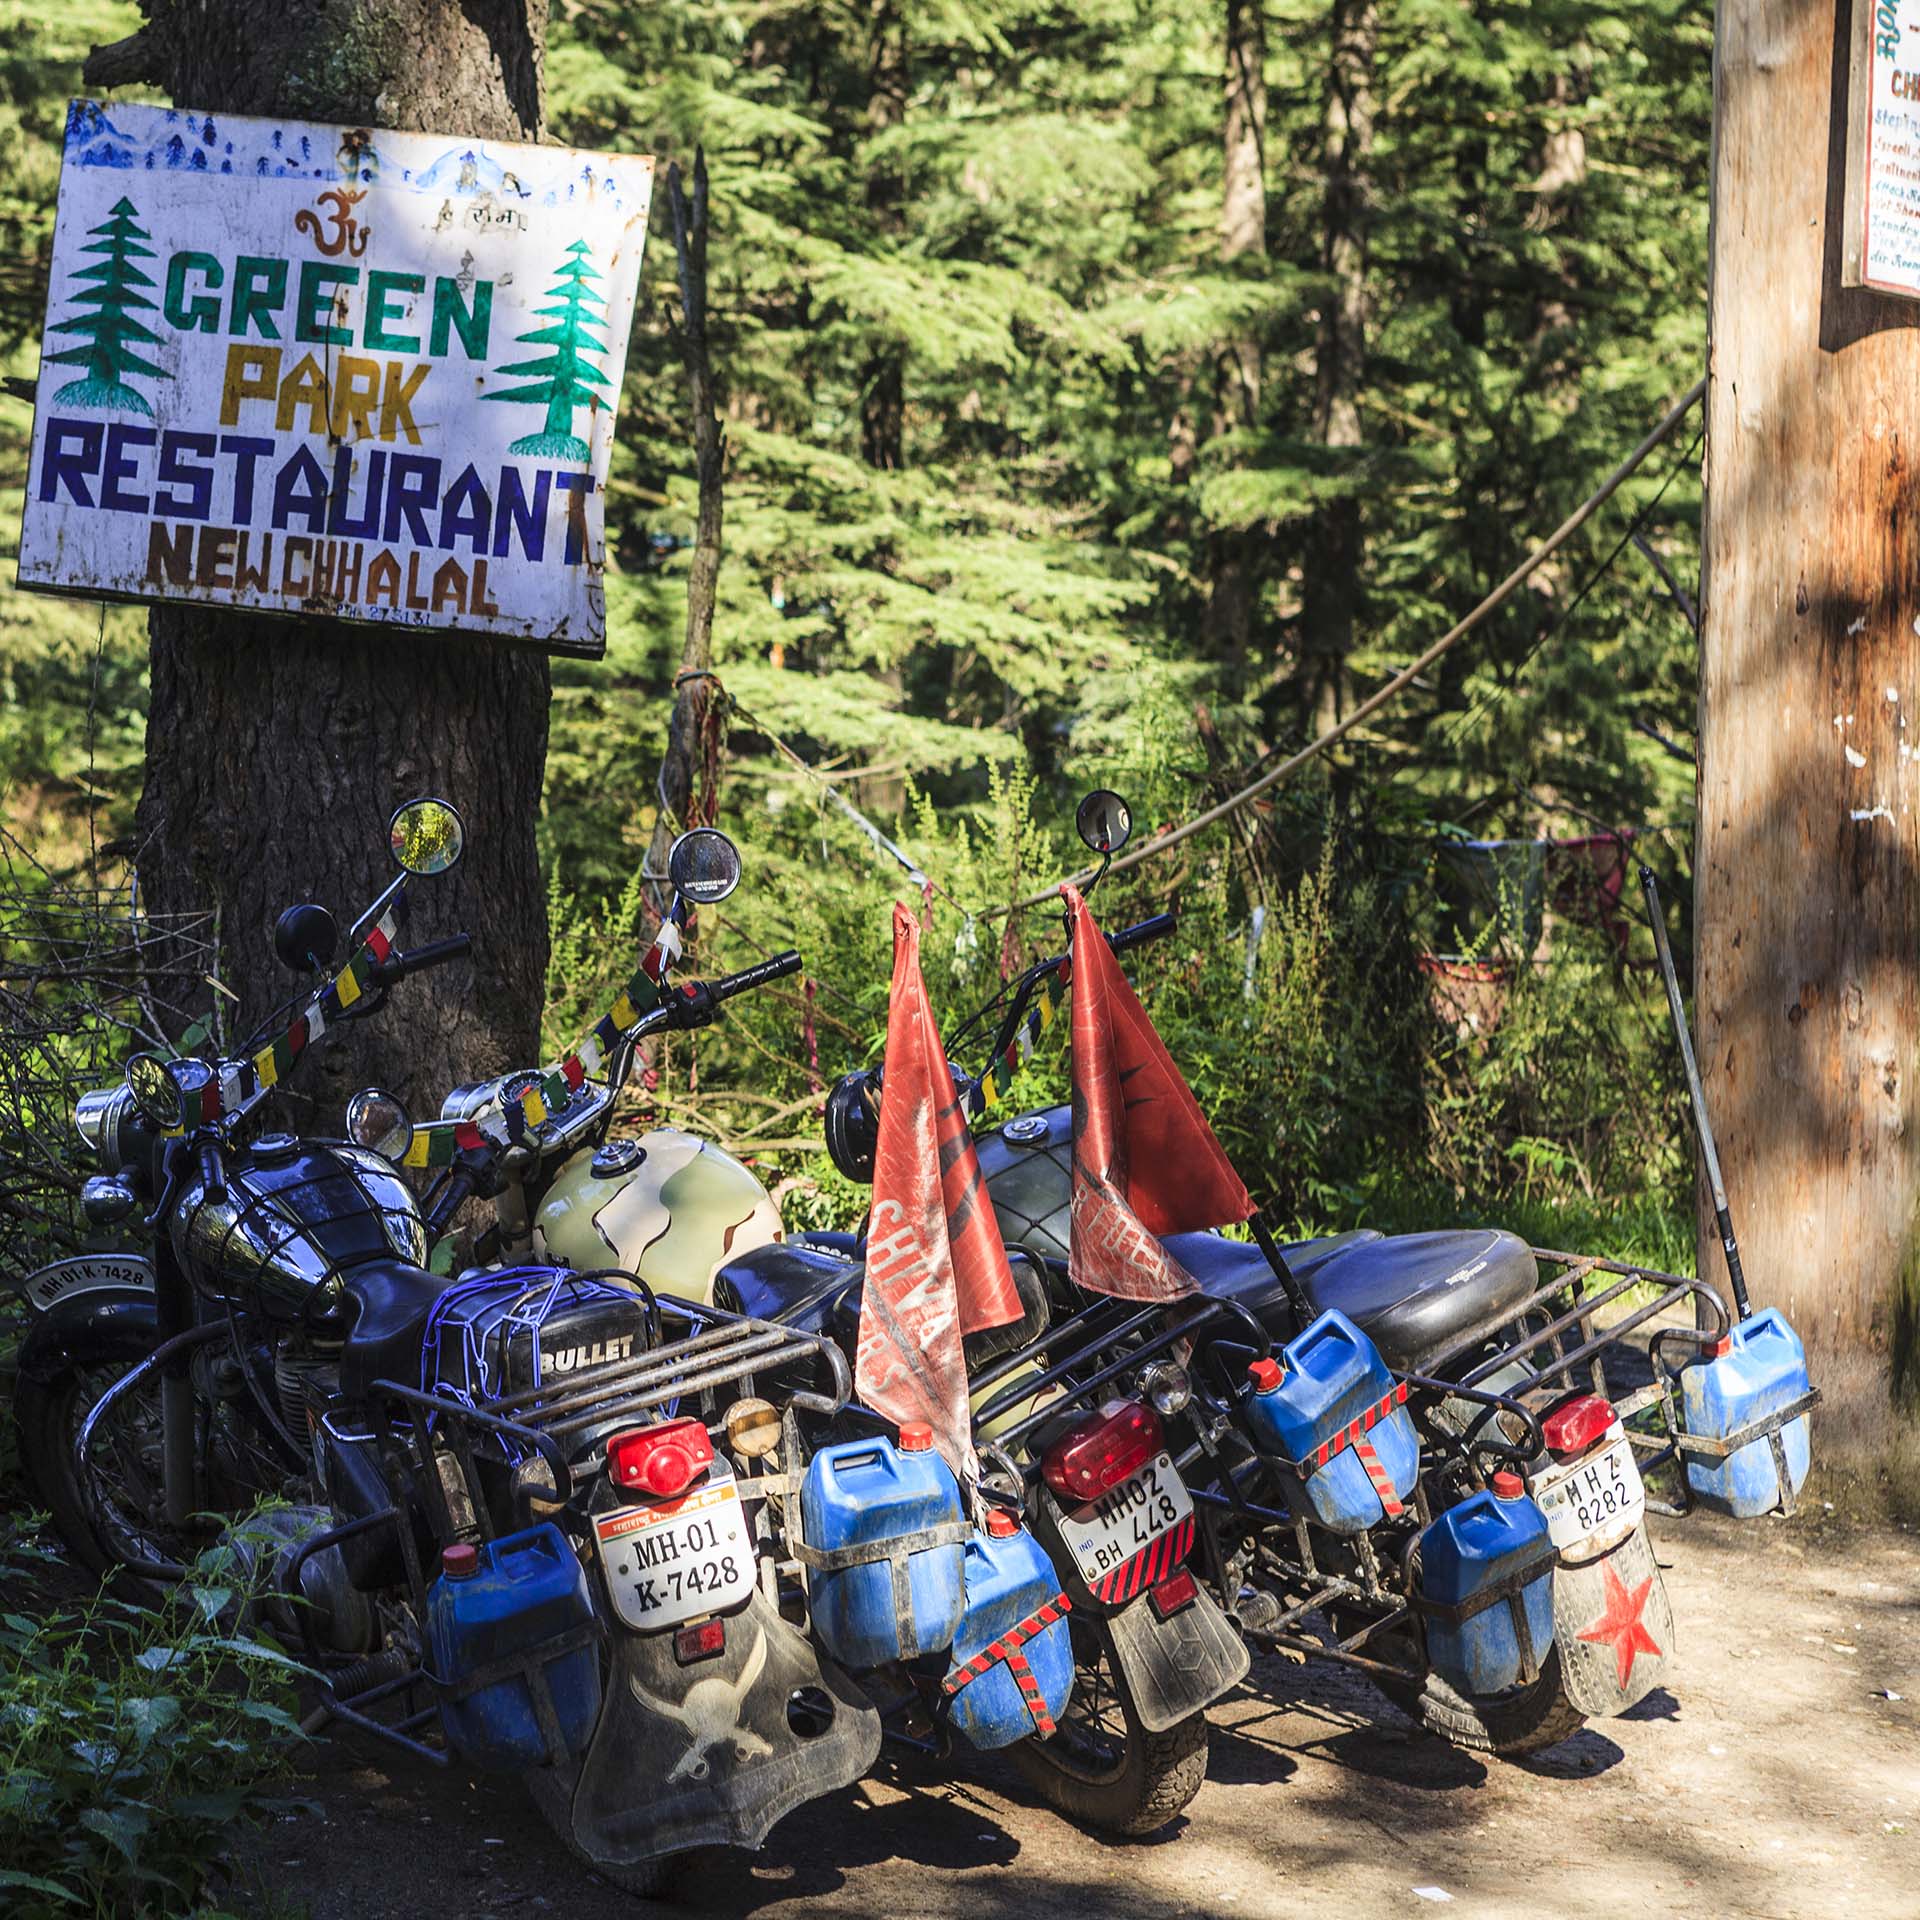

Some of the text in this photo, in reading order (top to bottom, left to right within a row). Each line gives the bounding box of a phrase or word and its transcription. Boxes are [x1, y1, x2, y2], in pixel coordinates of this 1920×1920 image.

[163, 250, 493, 361] GREEN
[219, 343, 432, 445] PARK
[39, 416, 596, 566] RESTAURANT
[867, 1199, 956, 1350] SHIVA
[540, 1334, 634, 1375] BULLET
[1094, 1494, 1178, 1571] BH 448
[1577, 1482, 1631, 1530] 8282
[632, 1518, 720, 1572] MH-01
[633, 1556, 739, 1613] K-7428
